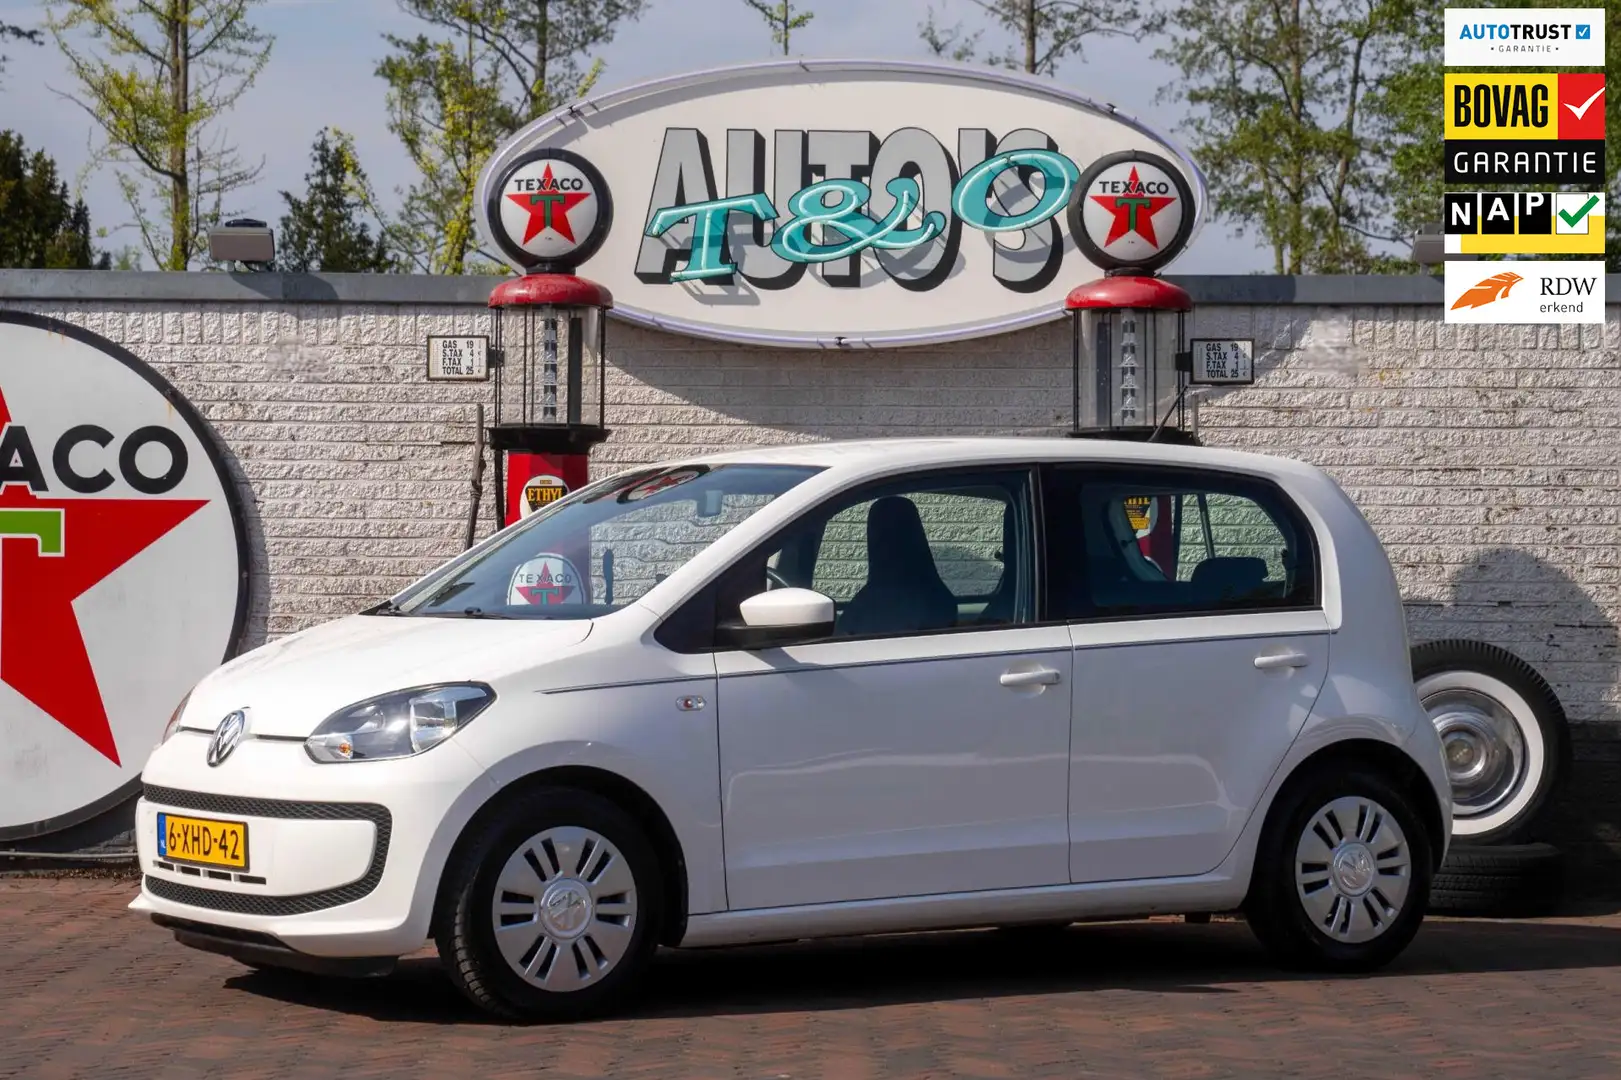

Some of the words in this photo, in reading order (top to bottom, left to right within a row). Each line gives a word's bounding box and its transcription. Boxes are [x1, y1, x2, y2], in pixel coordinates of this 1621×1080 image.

[514, 178, 584, 191] TEXACO
[1098, 181, 1170, 195] TEXACO
[442, 340, 457, 348] GAS
[466, 340, 474, 348] 19
[1206, 342, 1221, 351] GAS
[1230, 342, 1239, 351] 19
[442, 349, 463, 357] S.TAX
[1206, 352, 1227, 360] S.TAX
[442, 358, 461, 366] F.TAX
[1206, 361, 1226, 369] F.TAX
[442, 366, 463, 375] TOTAL
[466, 366, 474, 375] 25
[1206, 370, 1228, 378] TOTAL
[1230, 369, 1239, 378] 25
[519, 573, 572, 584] TEXACO
[169, 821, 240, 861] 6-XHD-42
